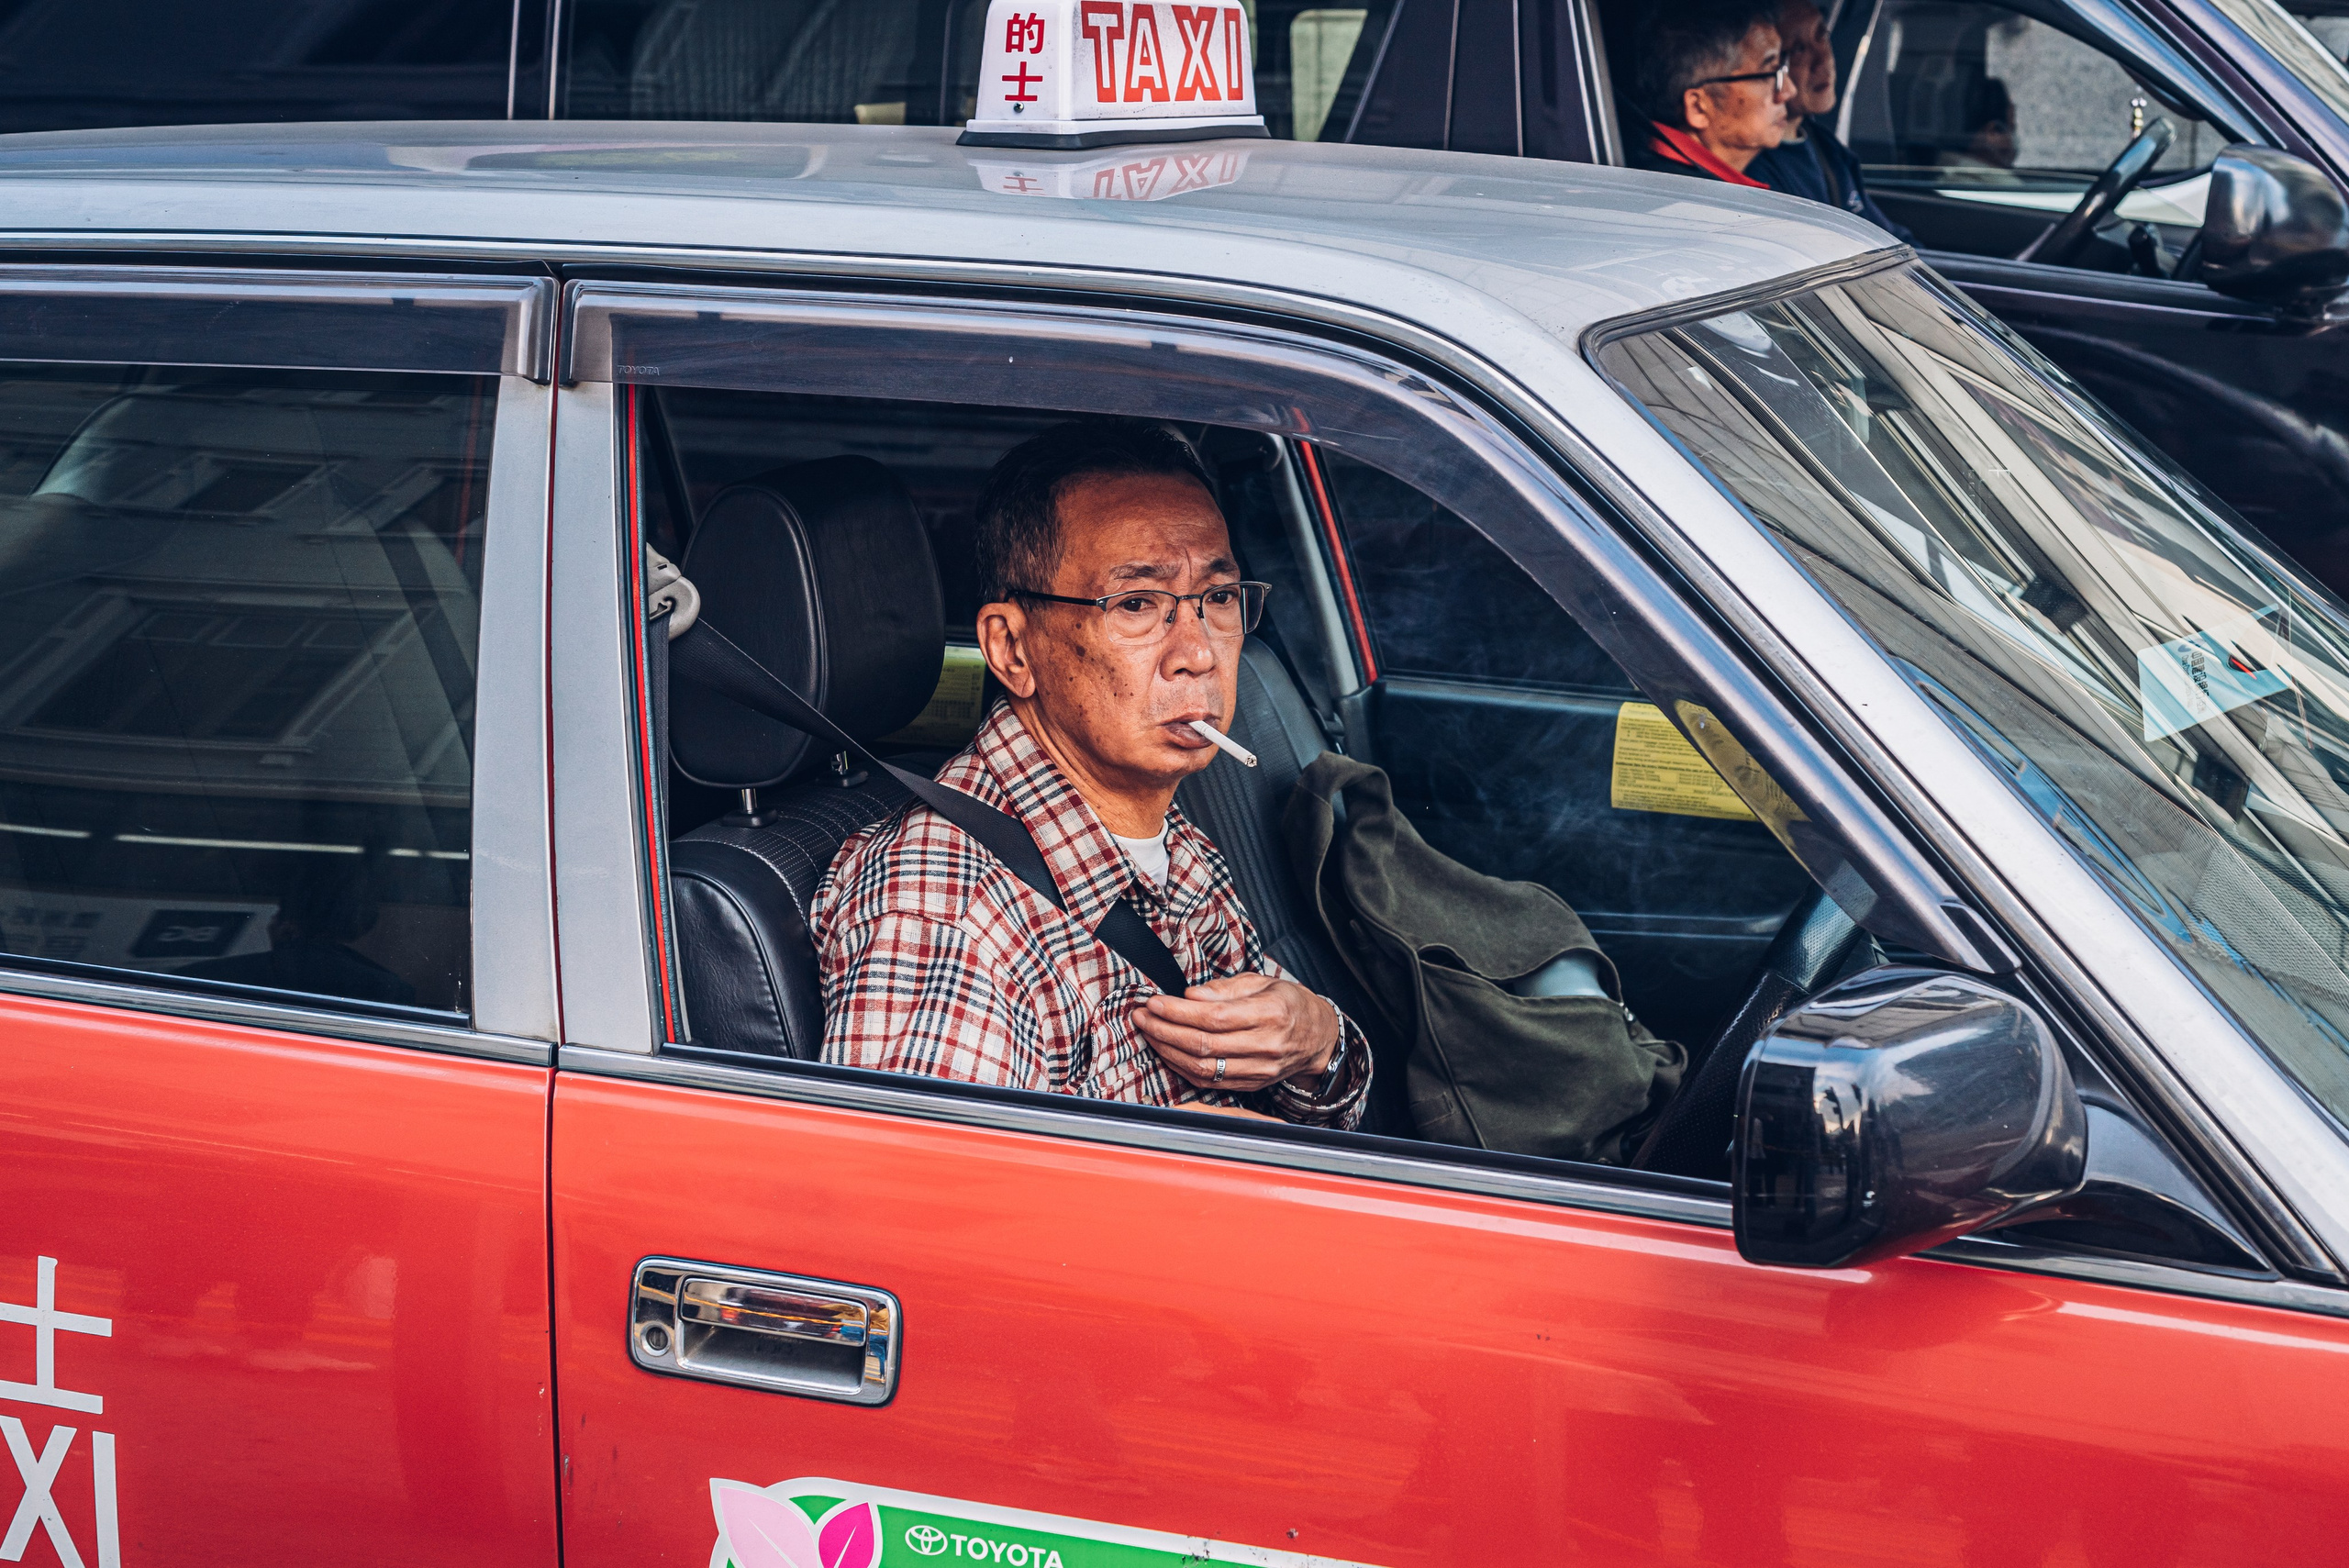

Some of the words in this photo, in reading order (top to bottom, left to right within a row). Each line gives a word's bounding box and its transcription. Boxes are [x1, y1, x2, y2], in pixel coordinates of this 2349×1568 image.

[1002, 12, 1045, 102] 的士
[1081, 0, 1243, 103] TAXI
[617, 364, 660, 376] TOYOTA
[0, 1255, 113, 1415] 士
[950, 1533, 1064, 1568] TOYOTA
